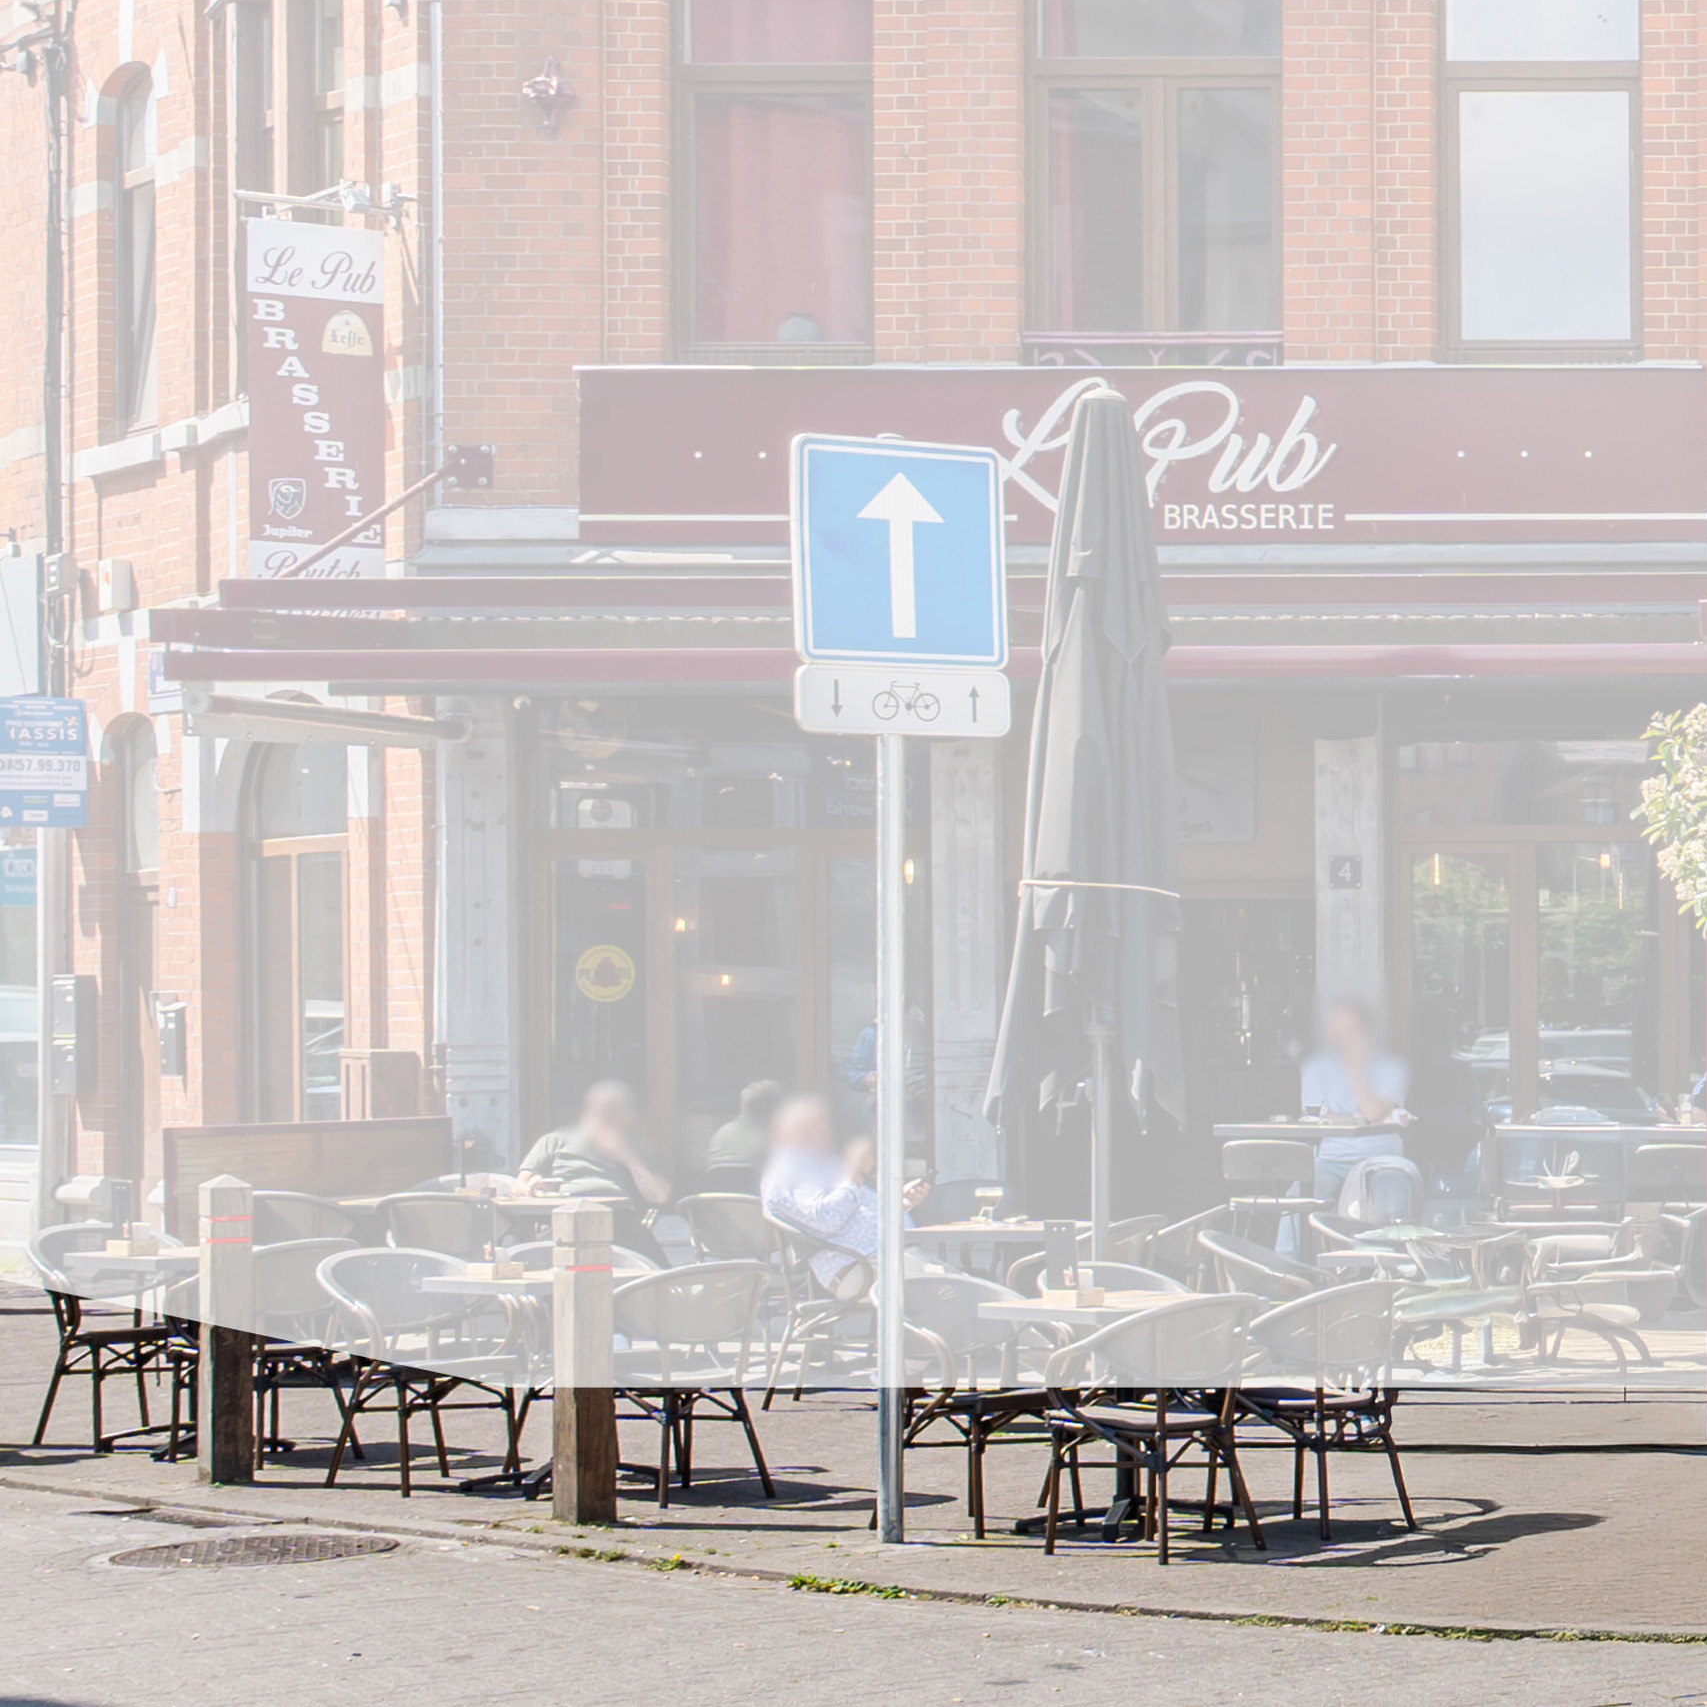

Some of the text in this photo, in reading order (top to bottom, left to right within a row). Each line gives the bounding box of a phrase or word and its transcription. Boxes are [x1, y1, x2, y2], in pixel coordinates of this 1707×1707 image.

[255, 246, 377, 295] Le Pub
[252, 299, 382, 544] BRASSERIE
[1134, 380, 1338, 508] Pub
[262, 524, 314, 539] Jupiler
[1164, 503, 1335, 531] BRASSERIE
[1338, 861, 1352, 882] 4
